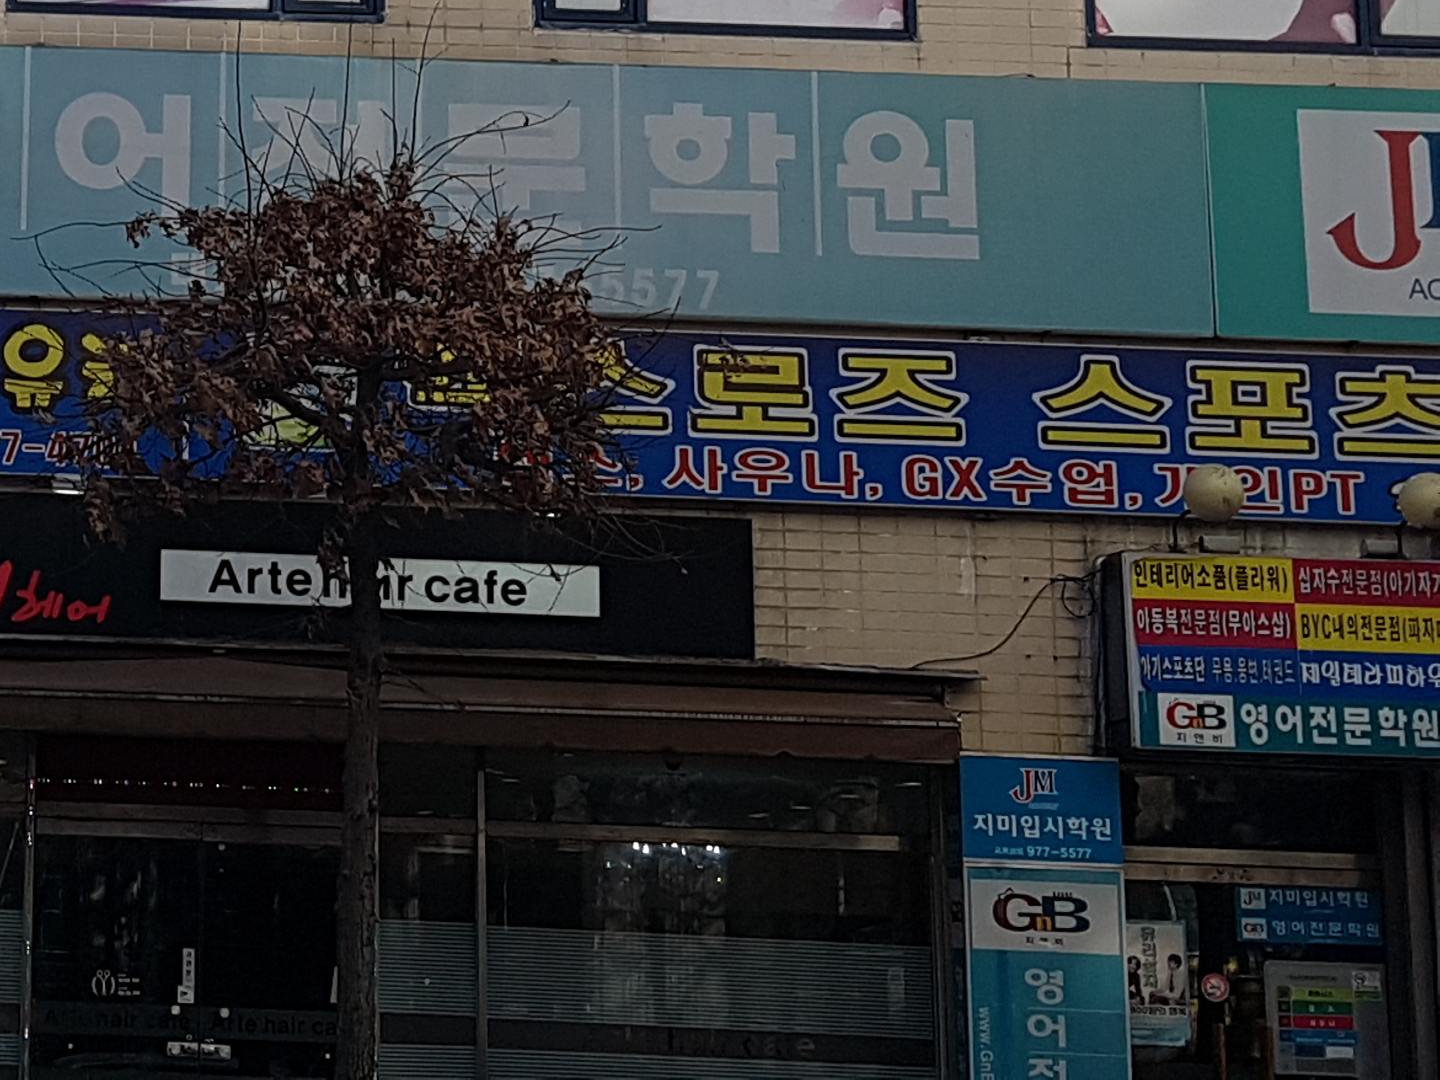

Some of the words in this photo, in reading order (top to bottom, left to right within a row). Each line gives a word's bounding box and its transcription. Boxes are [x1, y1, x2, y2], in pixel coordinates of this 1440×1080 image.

[424, 569, 529, 607] cafe
[972, 813, 1113, 842] 지미입시학원
[1026, 845, 1092, 860] 977-5577
[992, 887, 1091, 933] GnB
